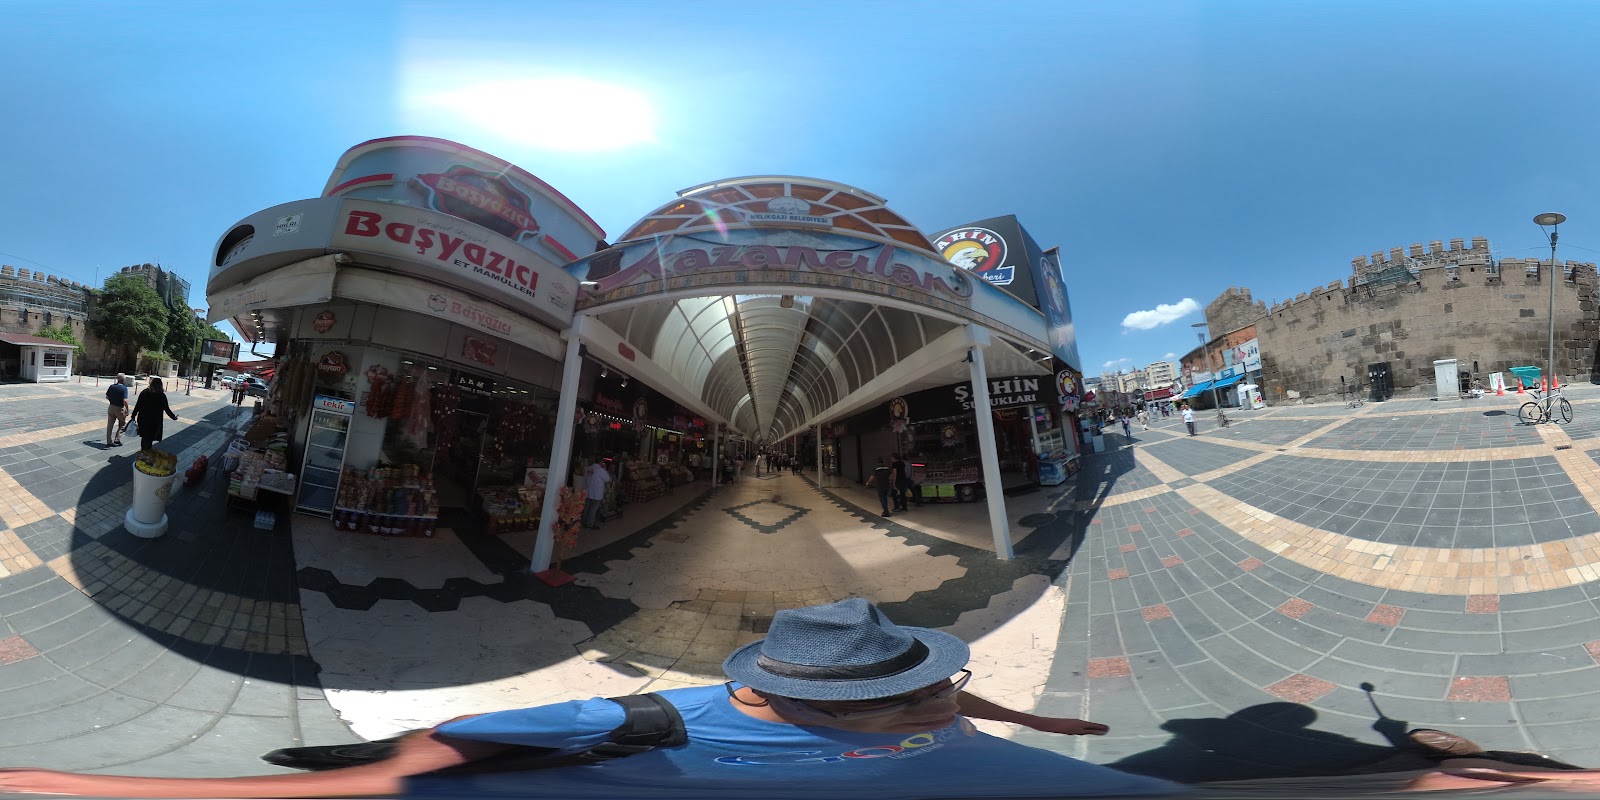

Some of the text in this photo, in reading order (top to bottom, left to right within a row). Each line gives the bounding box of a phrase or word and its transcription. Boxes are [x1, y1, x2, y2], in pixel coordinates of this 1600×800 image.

[436, 176, 530, 228] Başyazıcı
[344, 210, 539, 291] Başyazıcı
[936, 229, 998, 250] AHİN
[453, 259, 470, 269] ET
[473, 266, 536, 298] MAMÜLLERİ
[954, 376, 1039, 402] ŞHİN
[322, 398, 345, 409] tekir
[962, 394, 1037, 411] SUUKLARI
